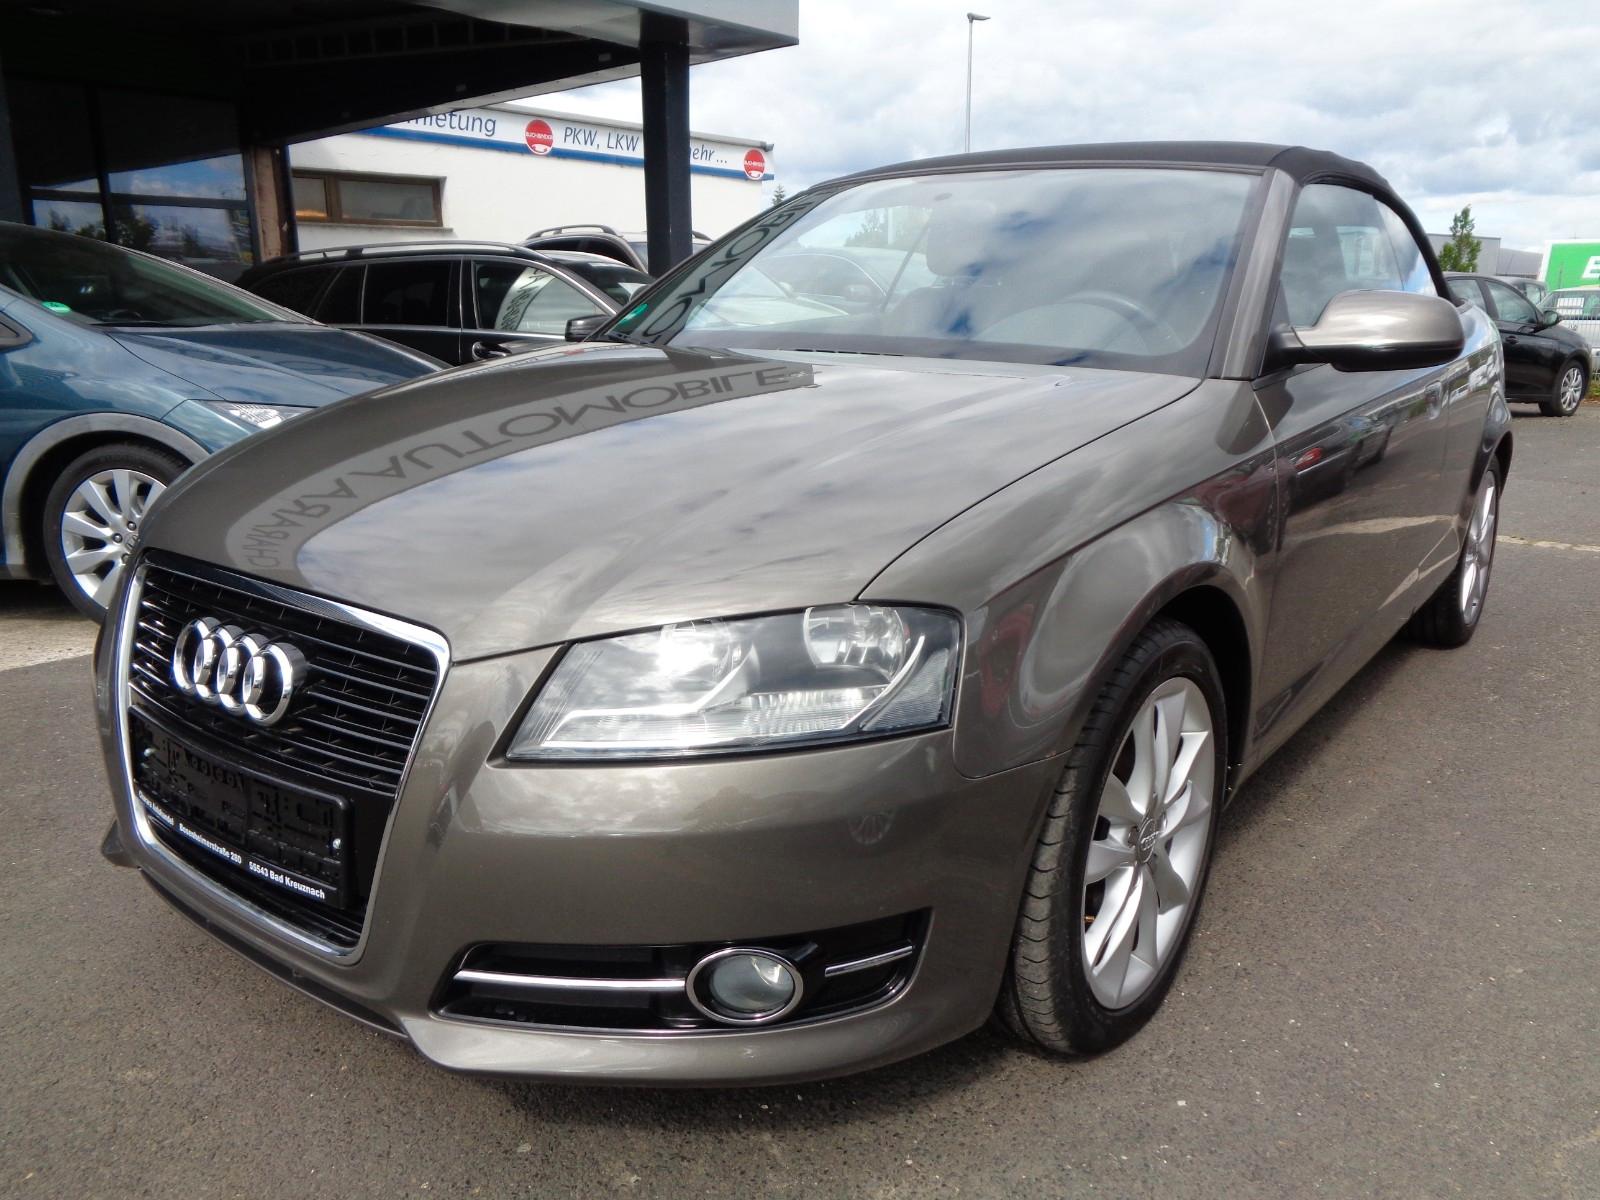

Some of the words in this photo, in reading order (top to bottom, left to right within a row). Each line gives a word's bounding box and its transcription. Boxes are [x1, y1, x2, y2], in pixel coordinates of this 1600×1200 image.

[563, 126, 600, 149] PKW,
[607, 131, 640, 152] LKW
[691, 144, 728, 164] ehr...
[269, 869, 284, 883] Bad
[284, 876, 325, 899] Kreuznach
